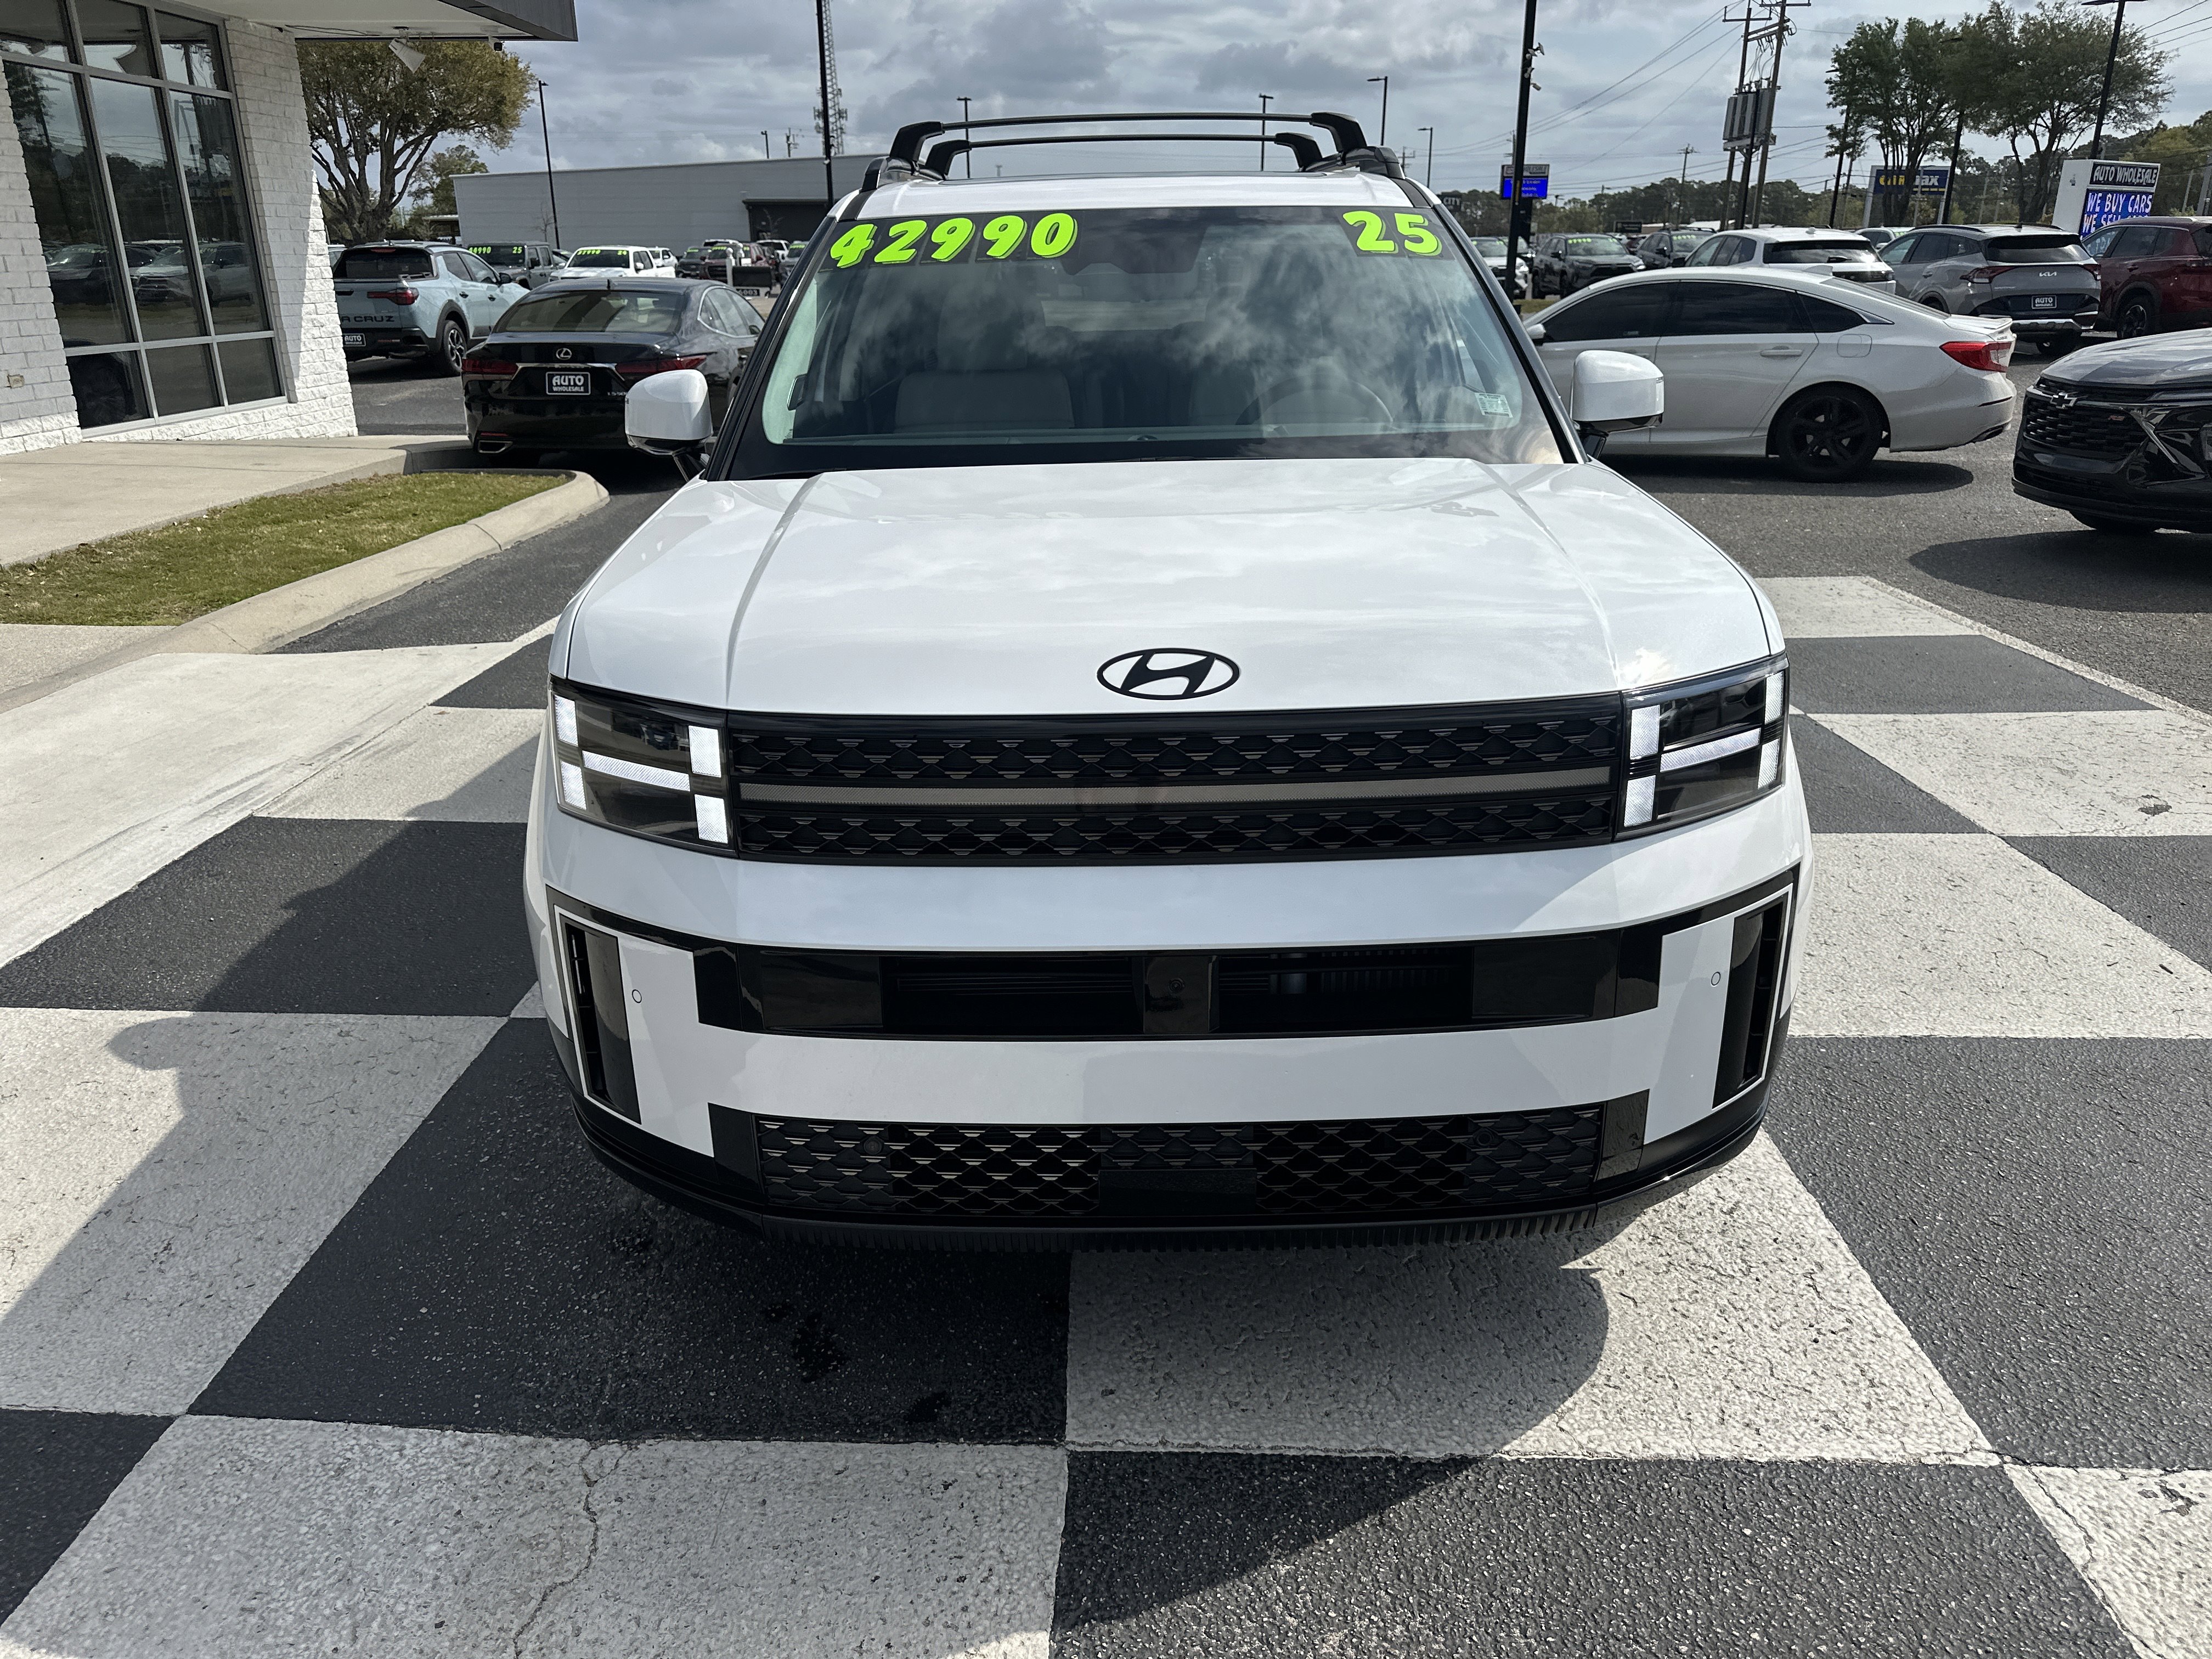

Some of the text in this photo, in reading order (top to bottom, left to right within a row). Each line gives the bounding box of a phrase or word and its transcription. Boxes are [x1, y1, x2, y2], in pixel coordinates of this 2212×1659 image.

[2093, 166, 2157, 184] AUTO WHOLESALE
[2086, 193, 2152, 213] WE BUY CARS
[2082, 213, 2097, 233] WE
[830, 212, 1077, 268] 42990
[1342, 211, 1443, 257] 25
[552, 375, 584, 386] AUTO
